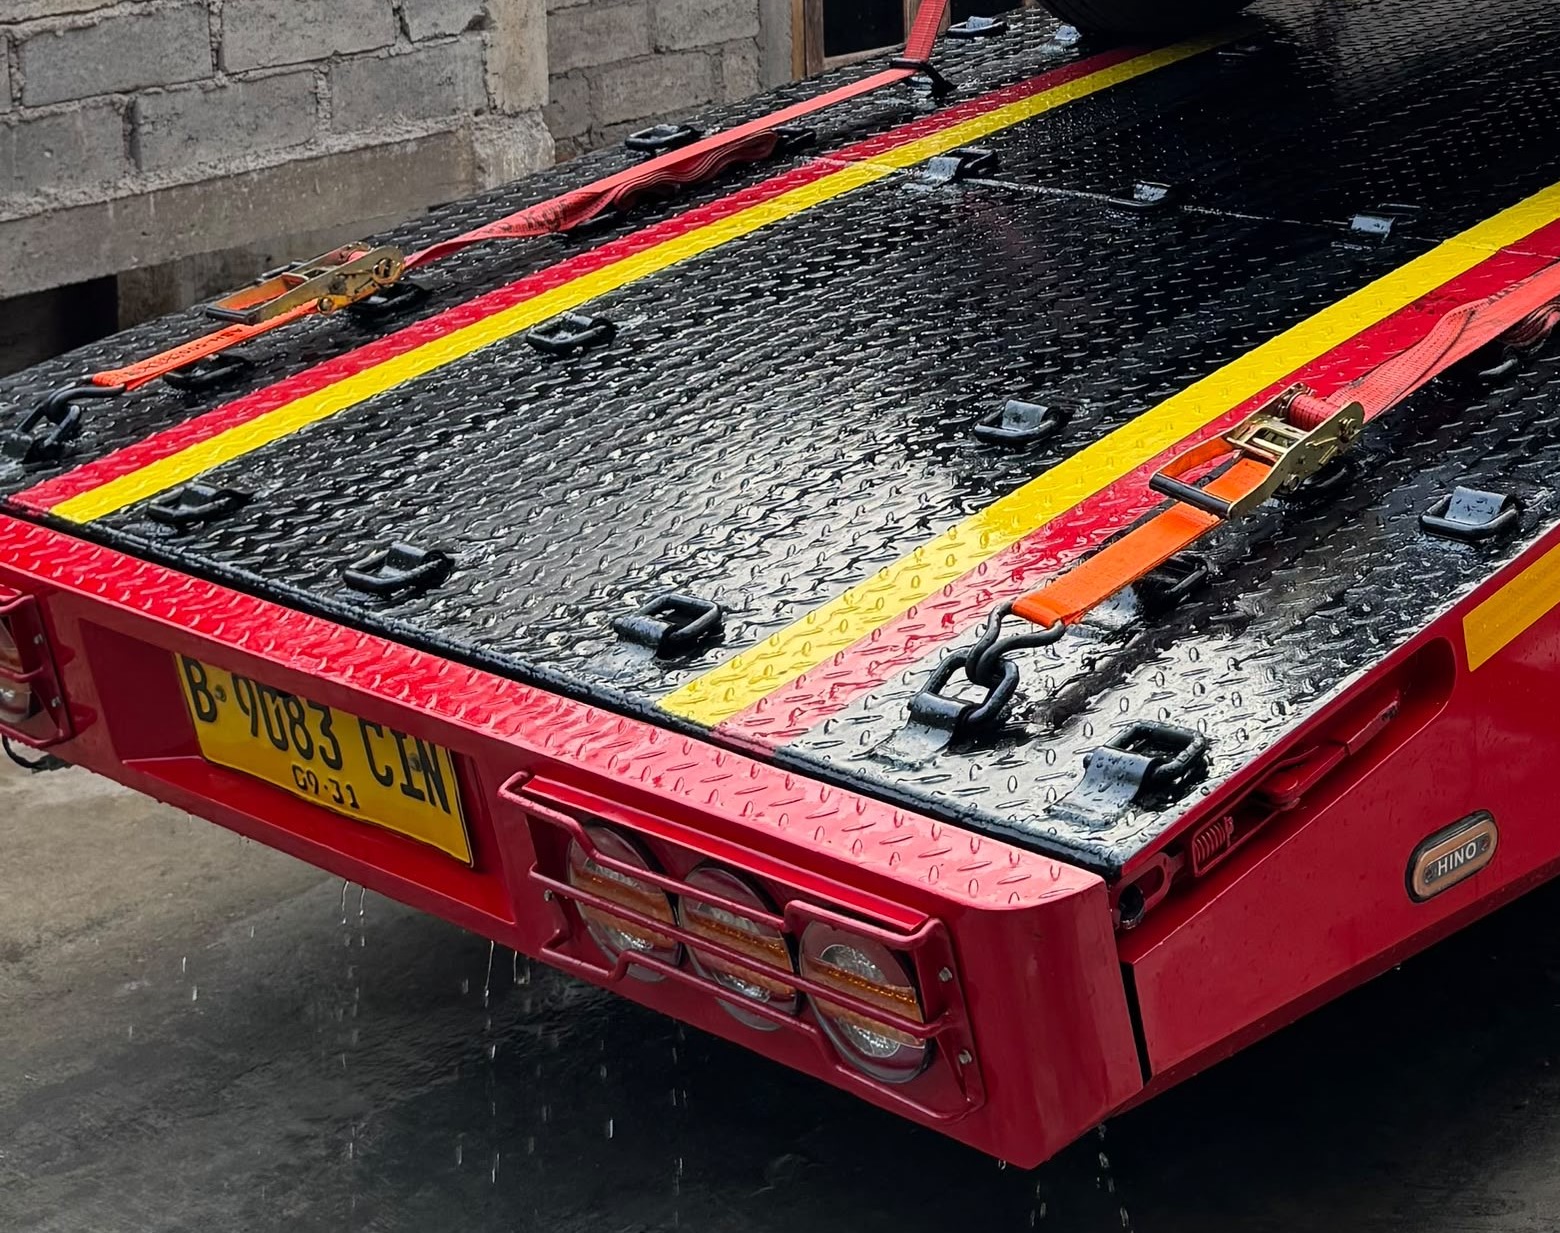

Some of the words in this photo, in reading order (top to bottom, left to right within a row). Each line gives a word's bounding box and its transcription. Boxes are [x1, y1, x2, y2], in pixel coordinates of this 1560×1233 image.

[182, 656, 217, 723] B
[231, 672, 343, 771] 9083
[358, 717, 451, 815] CIN
[1437, 842, 1477, 876] HINO
